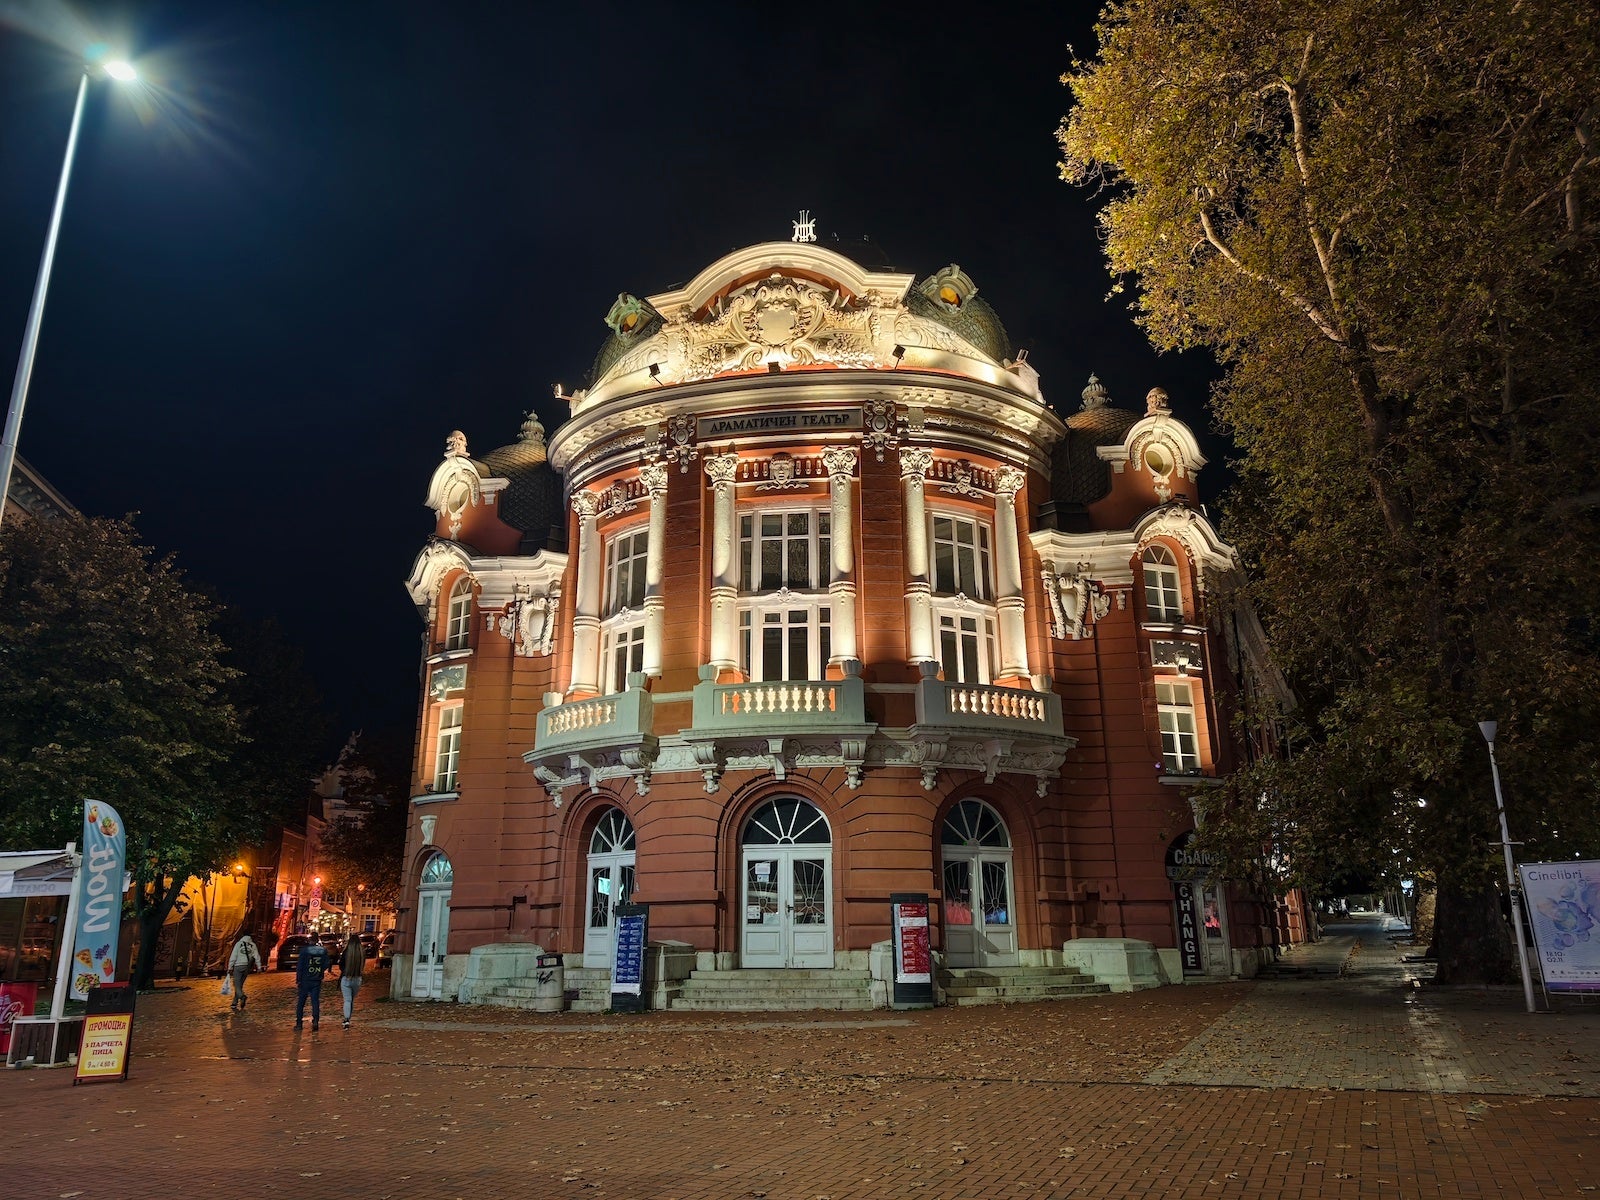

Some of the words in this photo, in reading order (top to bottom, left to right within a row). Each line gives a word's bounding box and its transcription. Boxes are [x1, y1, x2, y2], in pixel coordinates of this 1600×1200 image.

[710, 415, 796, 433] ДРАМАТИЧЕН
[802, 413, 850, 426] ТЕАТЪР
[1528, 869, 1582, 881] Cinelibri
[1180, 886, 1197, 967] CHANGE
[88, 1020, 126, 1031] ПРОМОЦИЯ
